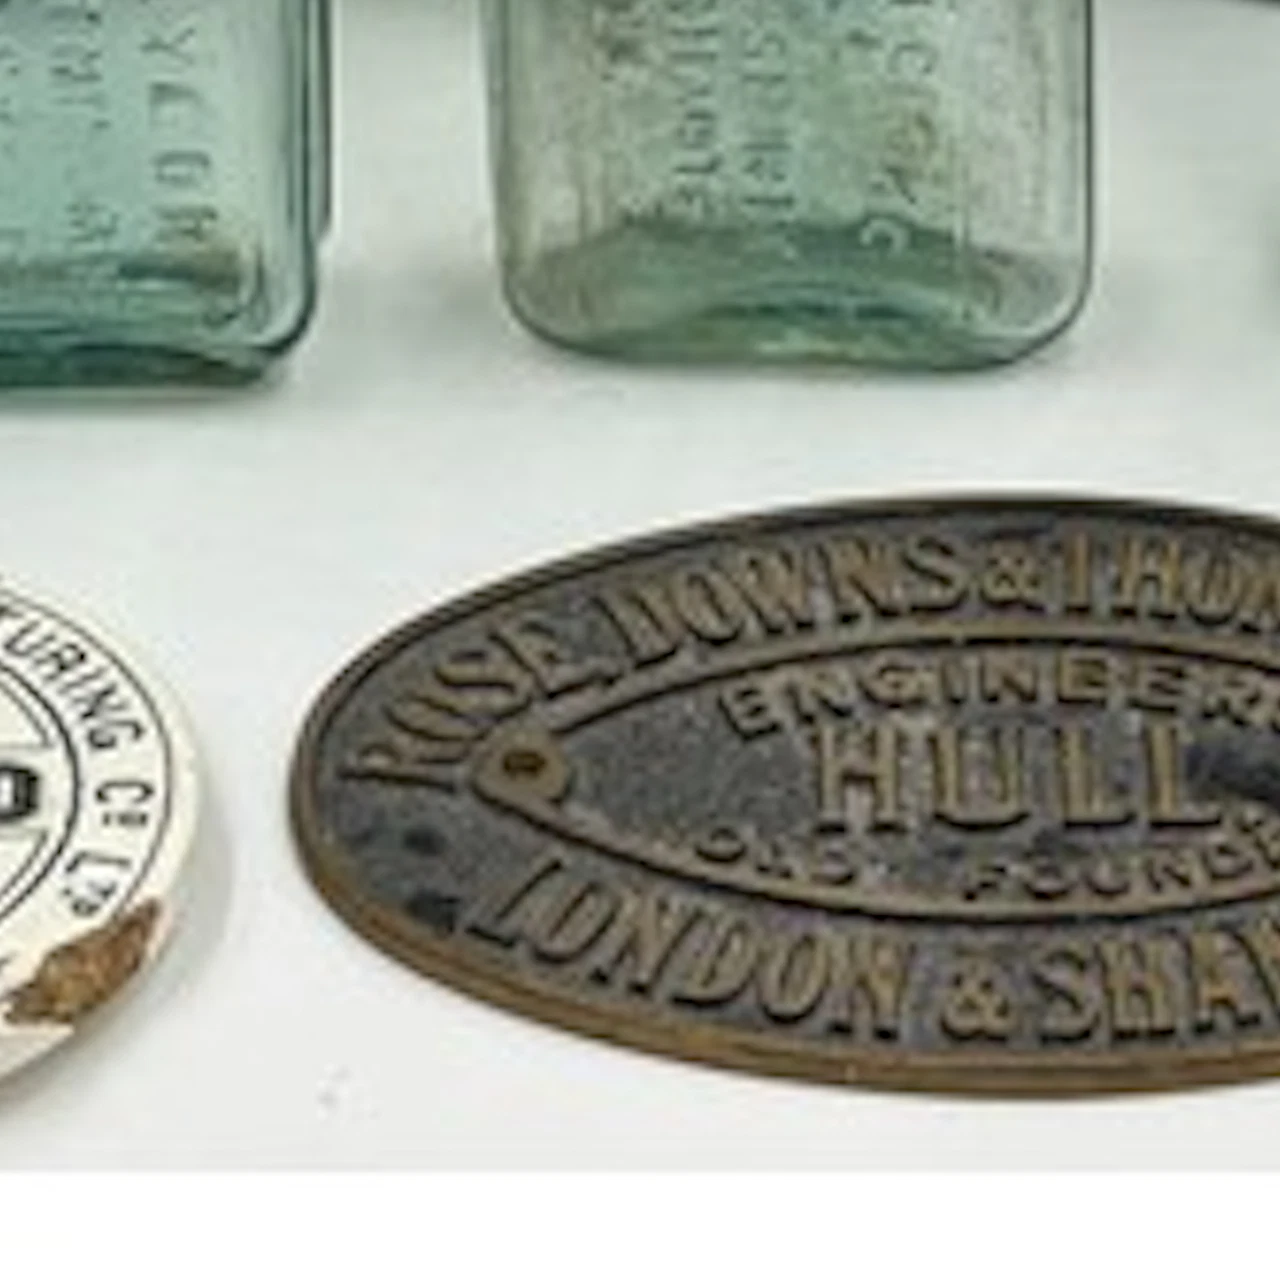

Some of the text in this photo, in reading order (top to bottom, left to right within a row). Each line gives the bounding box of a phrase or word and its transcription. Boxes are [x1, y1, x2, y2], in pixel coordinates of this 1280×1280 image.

[588, 540, 970, 670] DOWNS
[977, 548, 1047, 614] &
[464, 857, 916, 1041] LONDON
[937, 955, 1020, 1042] &
